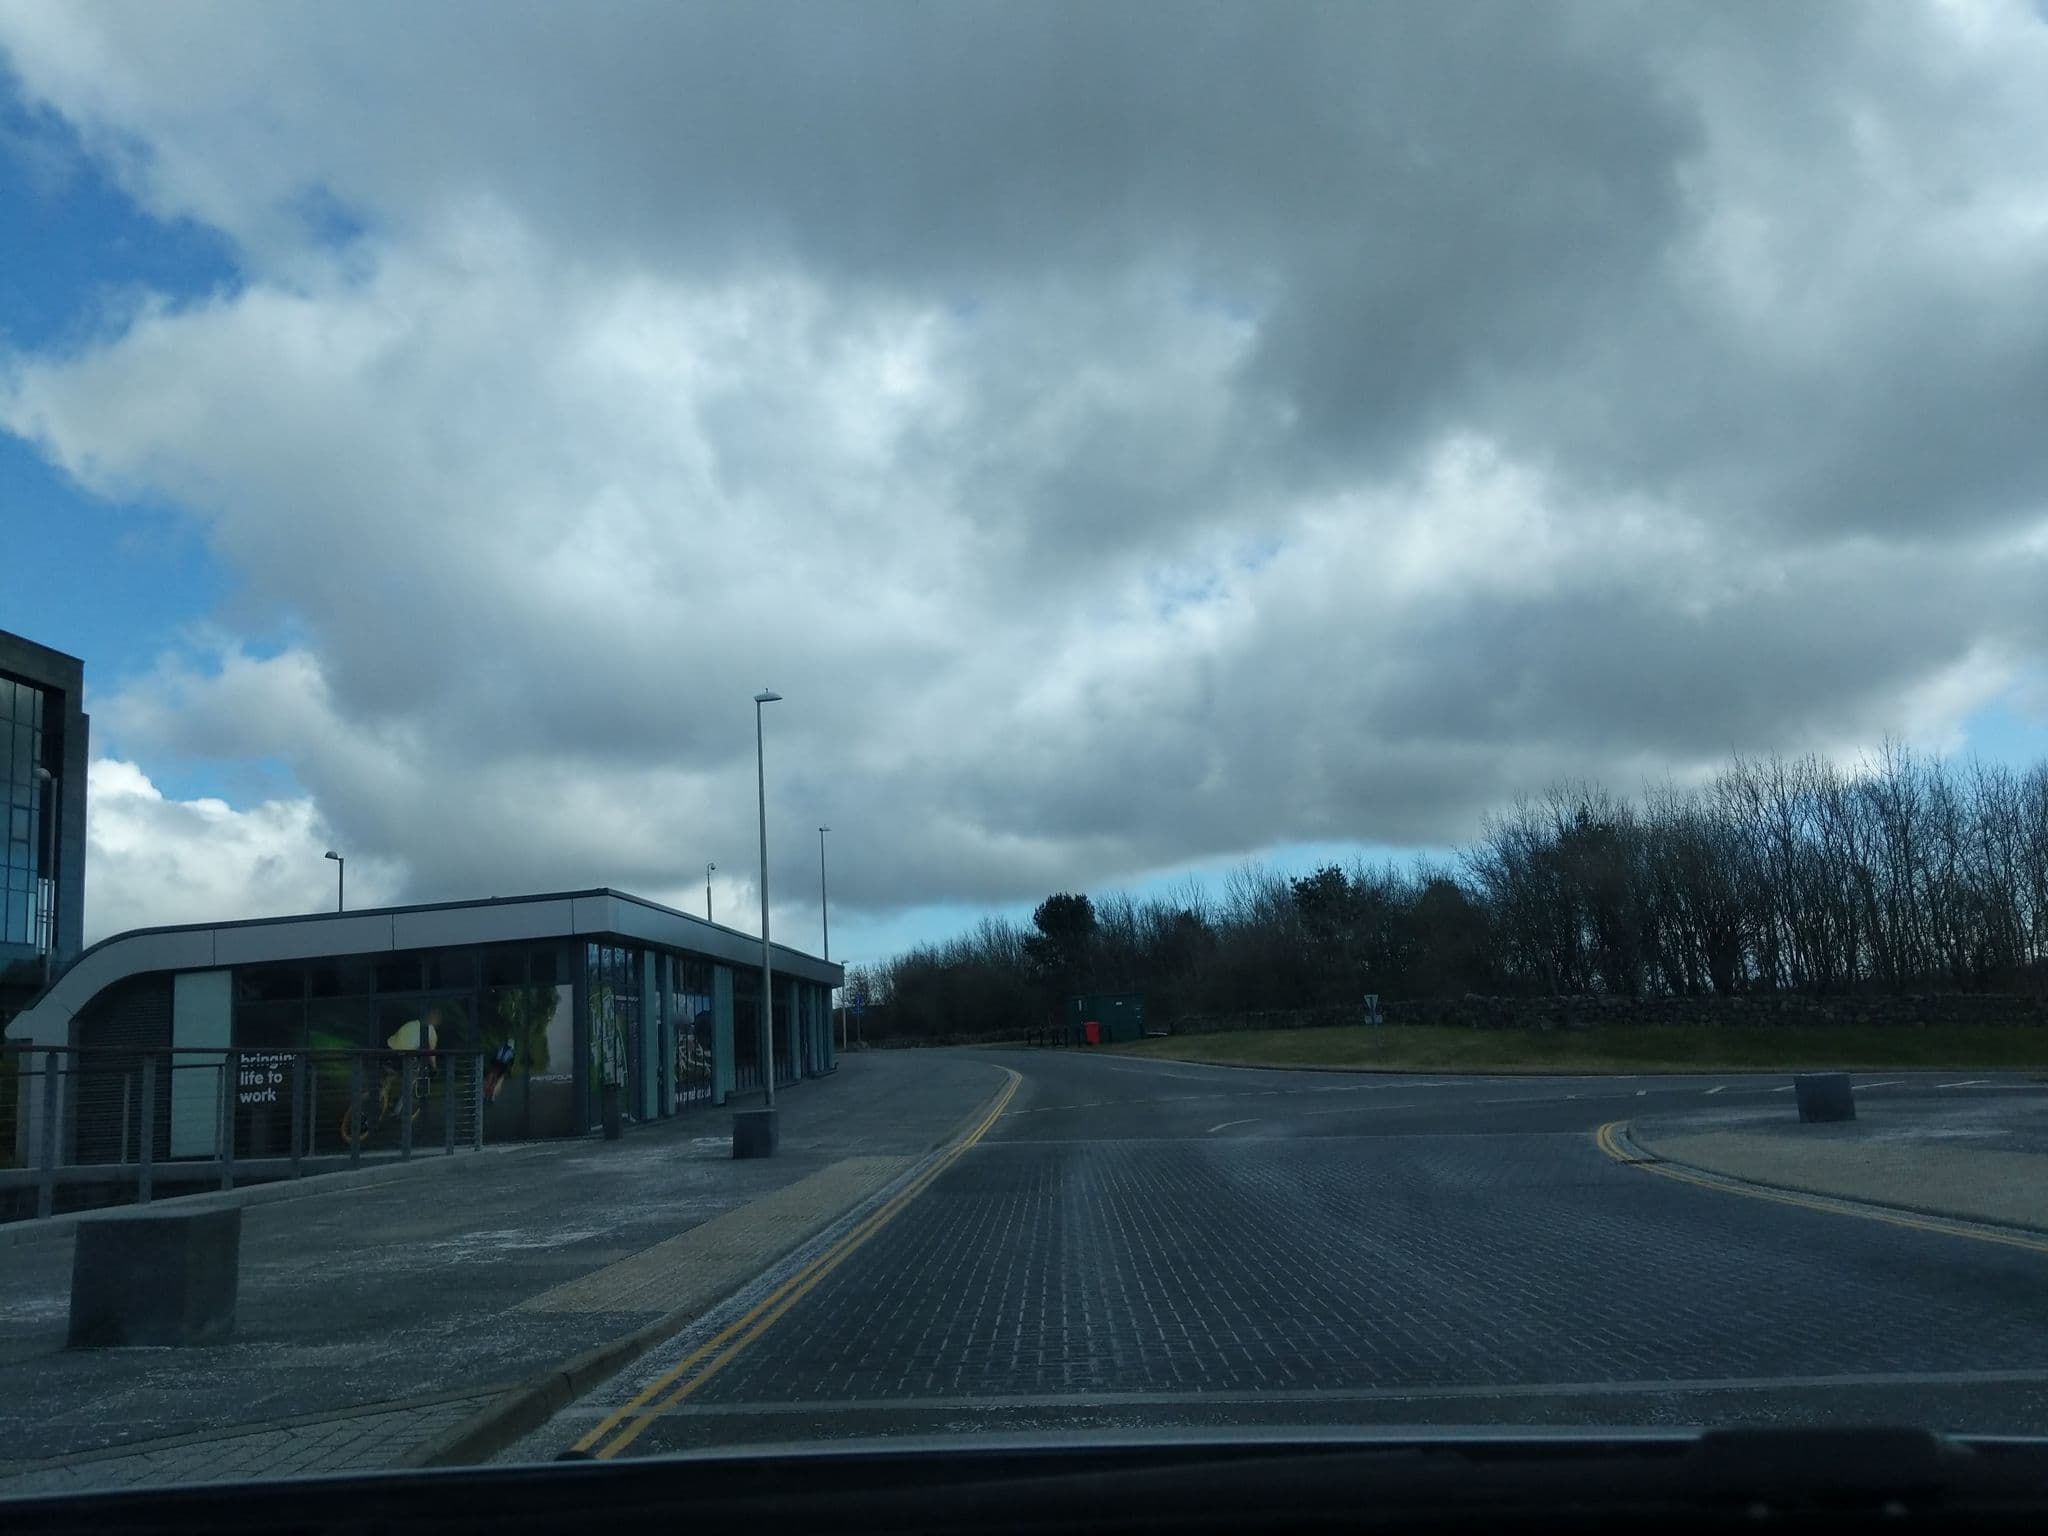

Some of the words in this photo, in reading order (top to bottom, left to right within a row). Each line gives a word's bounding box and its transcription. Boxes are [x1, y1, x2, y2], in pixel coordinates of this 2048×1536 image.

[240, 1071, 264, 1086] life
[268, 1070, 283, 1083] to
[240, 1087, 276, 1103] work
